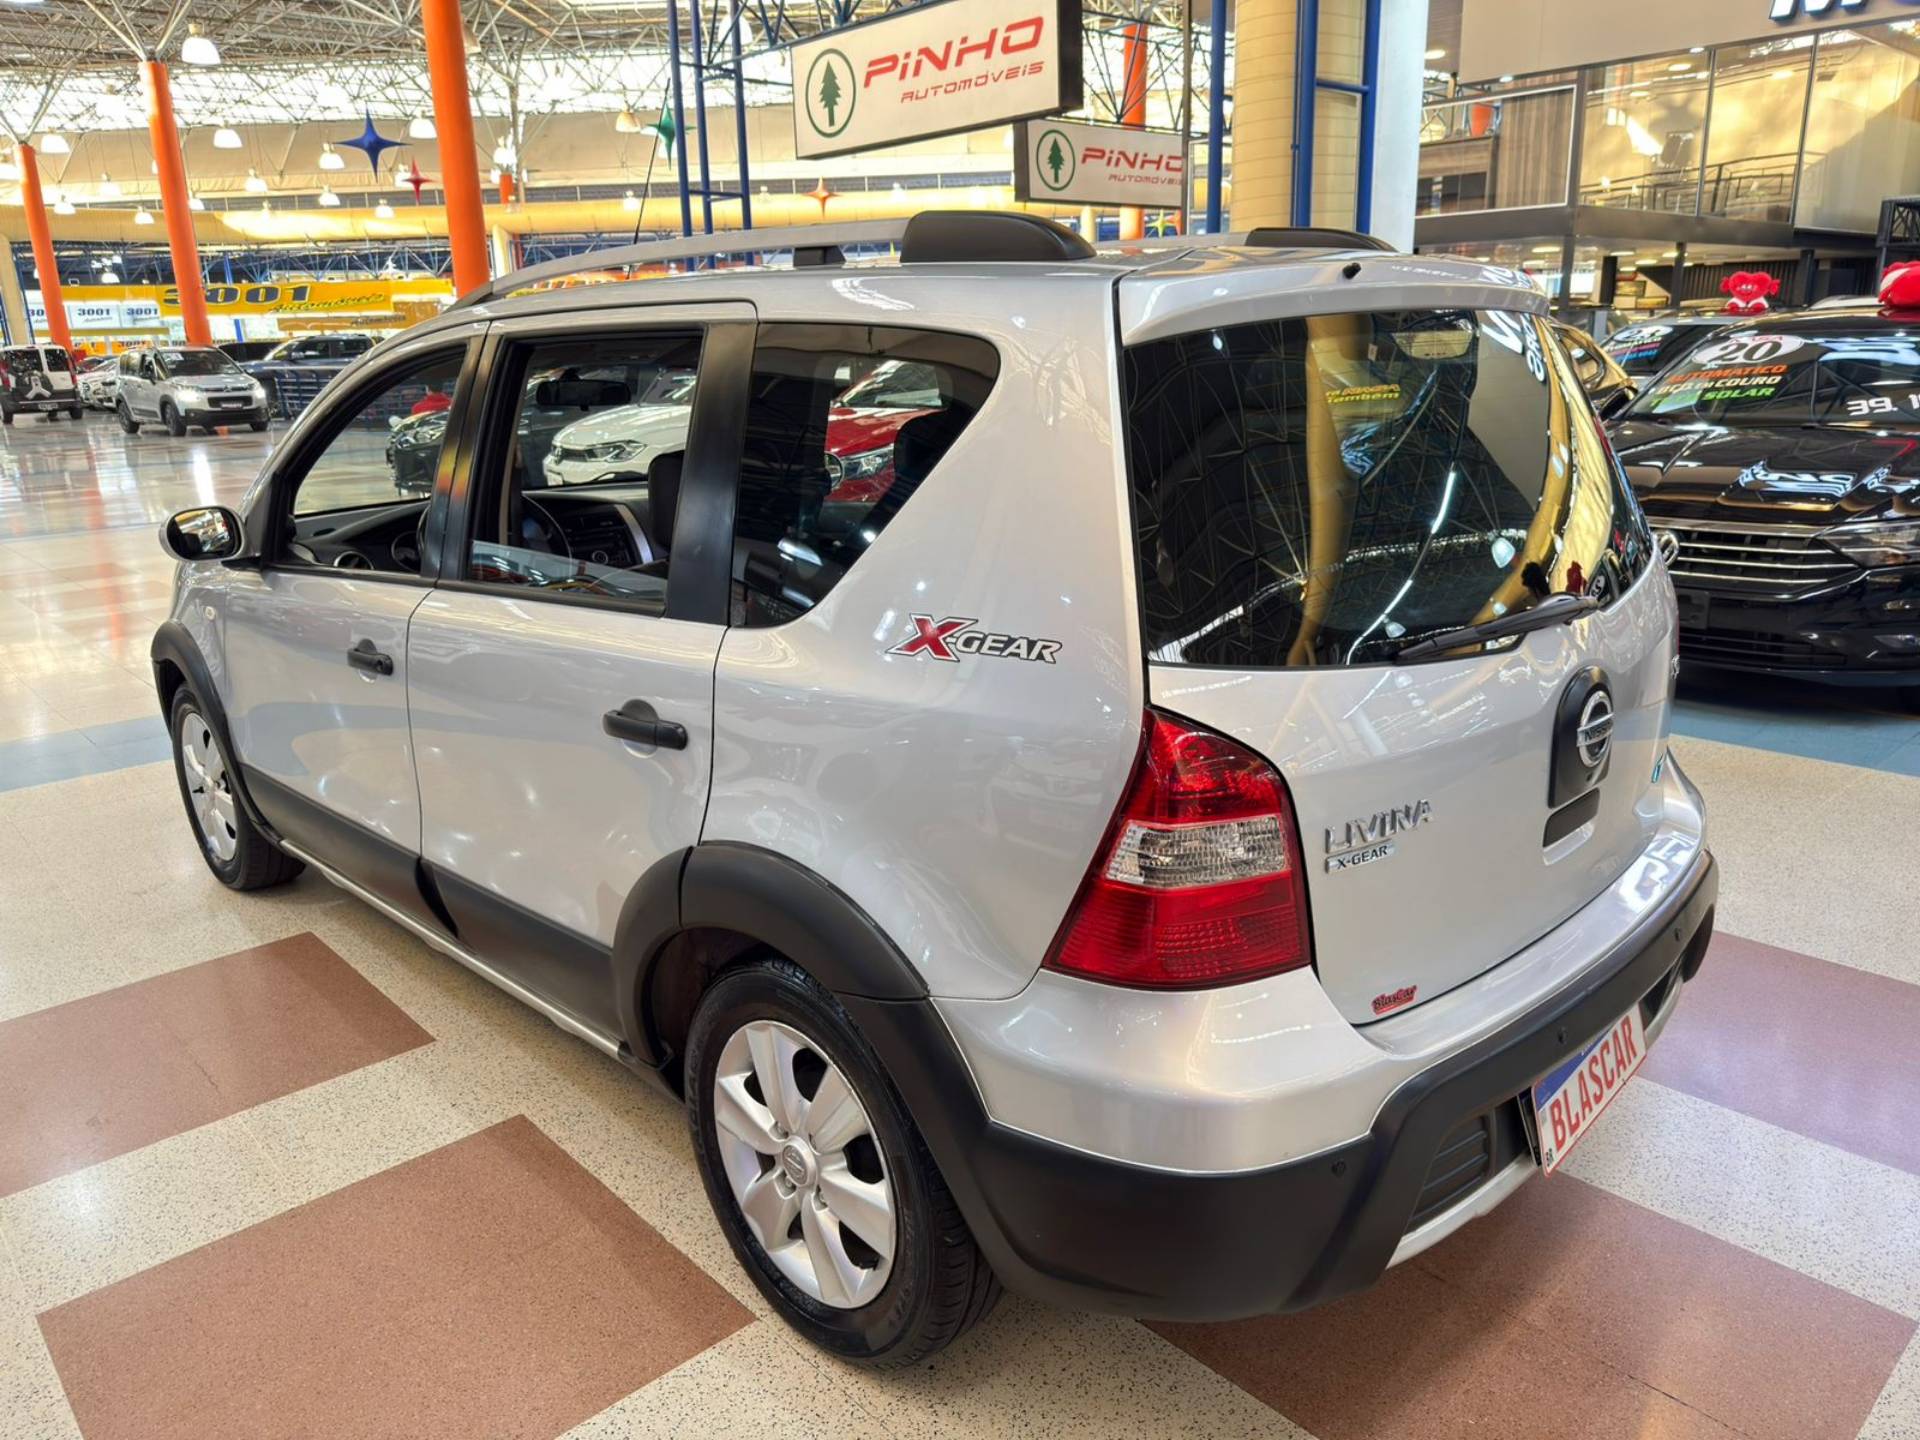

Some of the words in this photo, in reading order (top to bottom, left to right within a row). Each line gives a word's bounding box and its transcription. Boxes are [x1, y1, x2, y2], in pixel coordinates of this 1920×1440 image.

[1708, 340, 1783, 363] 20
[885, 613, 1062, 664] X-GEAR
[1324, 799, 1435, 854] LIVINA
[1336, 845, 1389, 870] X-GEAR
[1549, 1014, 1638, 1153] BLASCAR
